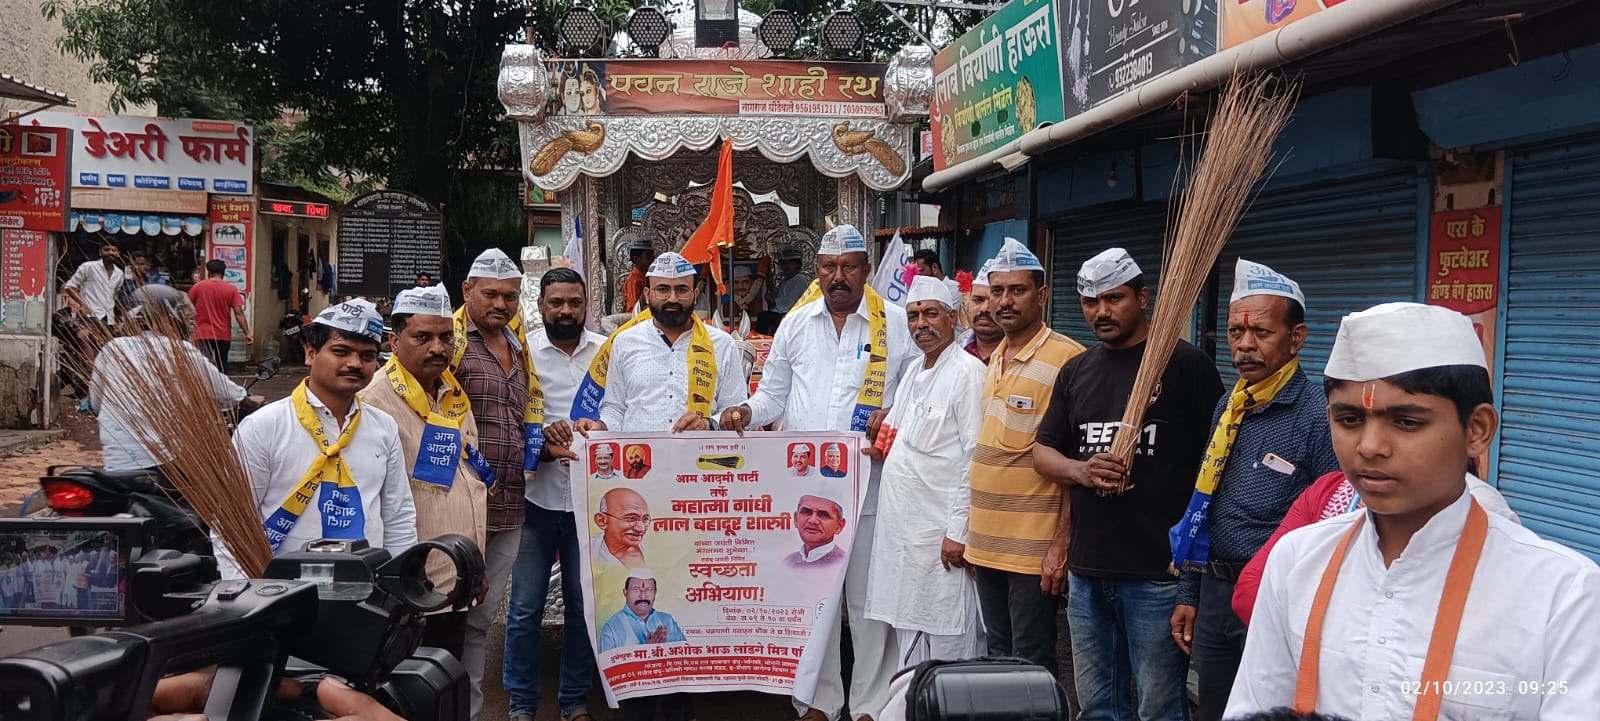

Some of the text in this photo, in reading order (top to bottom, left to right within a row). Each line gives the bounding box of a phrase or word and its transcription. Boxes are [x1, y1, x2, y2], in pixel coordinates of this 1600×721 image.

[693, 66, 750, 97] राजे
[762, 66, 828, 100] शाही
[838, 76, 880, 99] रथ
[81, 118, 250, 166] डेअरी फार्म
[341, 303, 366, 318] पार्टी
[434, 432, 455, 442] आम
[426, 442, 458, 456] आदमी
[430, 454, 450, 467] पार्टी
[676, 470, 759, 484] आम आदमी पार्टी
[710, 486, 728, 497] तर्फे
[671, 494, 773, 514] महात्मा गांधी
[652, 512, 792, 536] लाल बहादूर शास्त्री
[688, 563, 757, 578] स्वच्छता
[706, 645, 731, 654] भाऊ
[734, 642, 764, 654] लांडगे
[767, 643, 789, 656] मित्र
